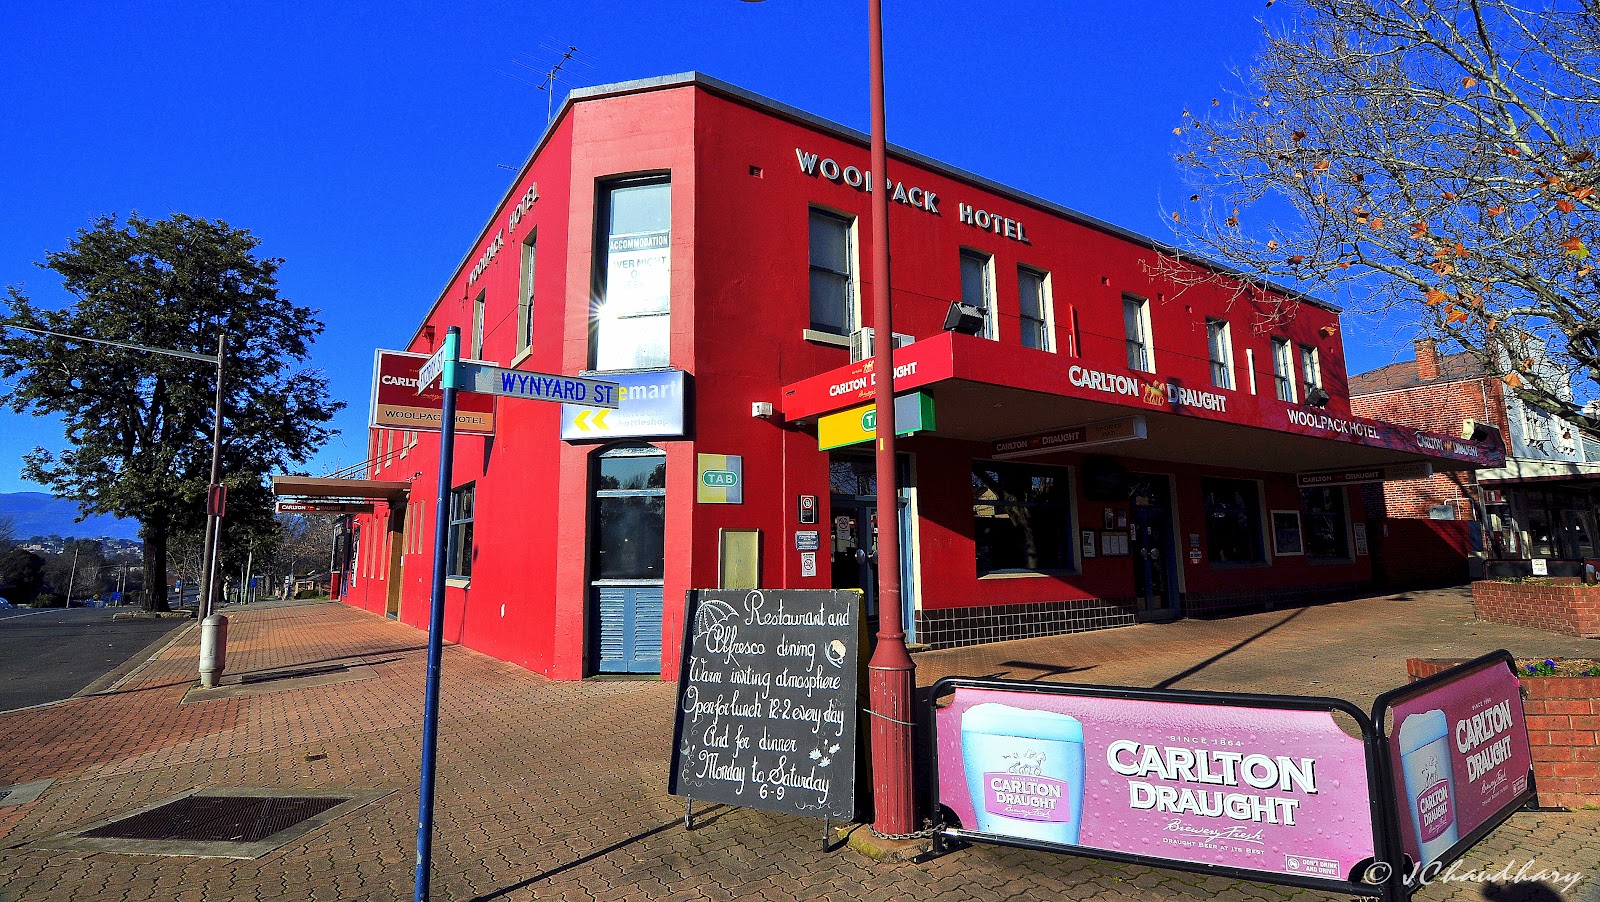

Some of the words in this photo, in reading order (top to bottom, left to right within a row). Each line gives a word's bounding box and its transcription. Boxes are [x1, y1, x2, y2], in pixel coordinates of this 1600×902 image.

[508, 181, 540, 234] HOTEL
[959, 202, 1029, 242] HOTEL
[609, 235, 669, 251] ACCOMMODATION
[382, 375, 433, 389] CARLT
[501, 372, 586, 402] WYNYARD
[594, 384, 614, 404] ST
[619, 381, 676, 401] emart
[829, 377, 867, 397] CARLTON
[871, 361, 918, 387] DUGHT
[1068, 365, 1139, 397] CARLTON
[1166, 383, 1227, 413] DRAUGHT
[385, 411, 442, 422] WOOLPAC
[1287, 408, 1349, 434] WOOLPACK
[1349, 421, 1380, 440] HOTEL
[996, 440, 1028, 452] CARLTON
[1042, 432, 1080, 446] DRAUGHT
[1417, 433, 1444, 452] CARLTON
[708, 474, 733, 484] TAB
[1302, 475, 1332, 484] CARLTON
[1345, 471, 1379, 480] DRAUGHT
[744, 590, 826, 627] Restaurant
[828, 603, 850, 627] and
[705, 623, 766, 665] Alfresco
[777, 634, 816, 672] dining
[689, 656, 722, 684] Warm
[730, 665, 771, 699] inviting
[776, 665, 841, 697] atmosphere
[768, 698, 791, 720] 12-2
[792, 704, 821, 734] every
[823, 698, 845, 737] day
[1455, 699, 1514, 754] CARLTON
[703, 724, 729, 748] And
[759, 726, 798, 752] dinner
[1170, 735, 1208, 745] SINCE
[1214, 738, 1242, 747] 1864
[1106, 739, 1319, 795] CARLTON
[1466, 735, 1512, 784] DRAUGHT
[696, 749, 746, 795] Monday
[752, 756, 765, 783] to
[767, 755, 829, 804] Saturday
[990, 777, 1062, 799] CARLTON
[996, 791, 1056, 810] DRAUGHT
[1128, 780, 1301, 827] DRAUGHT
[1420, 785, 1448, 814] CARLTON
[1423, 801, 1448, 827] DRAUGHT
[1163, 818, 1220, 843] Brewery
[1222, 825, 1264, 841] Fresh
